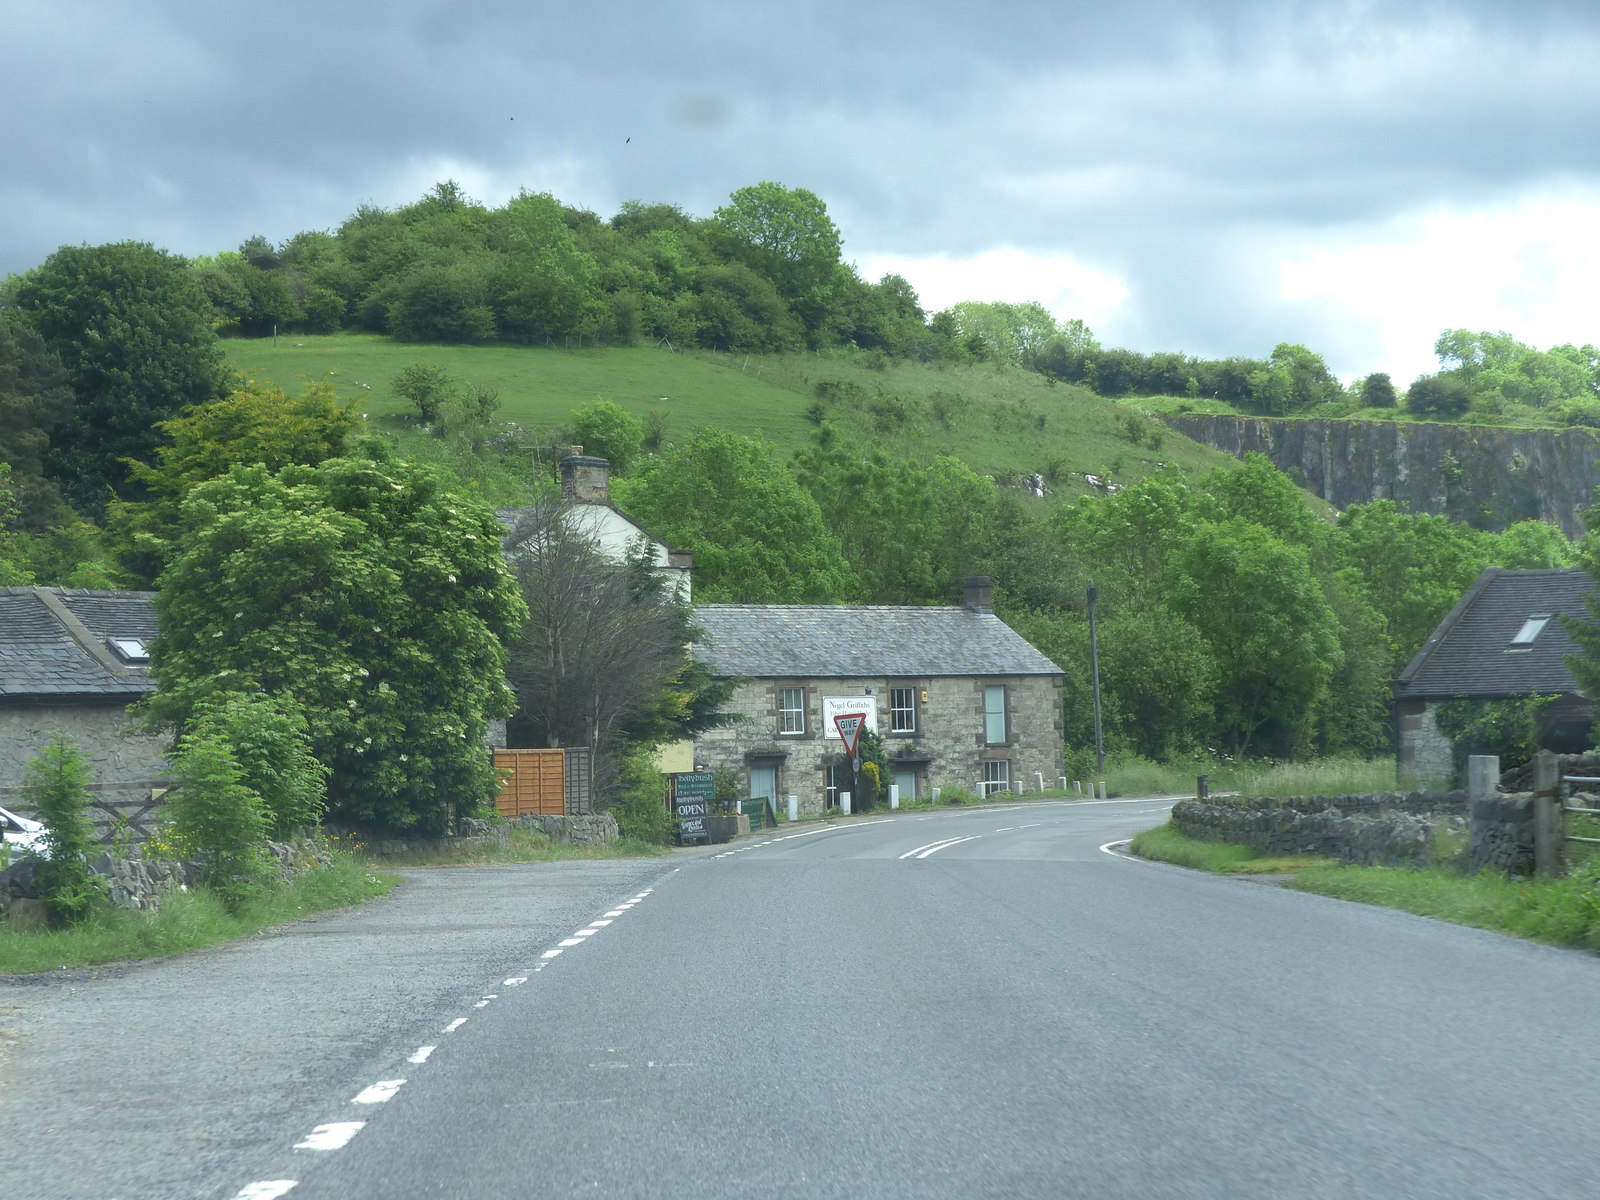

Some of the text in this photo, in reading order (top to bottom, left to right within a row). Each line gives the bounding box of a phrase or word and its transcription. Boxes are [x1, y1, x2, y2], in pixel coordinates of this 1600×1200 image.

[830, 700, 870, 709] Nigel Griffiths
[840, 720, 857, 729] GIVE
[678, 804, 704, 815] OPEN
